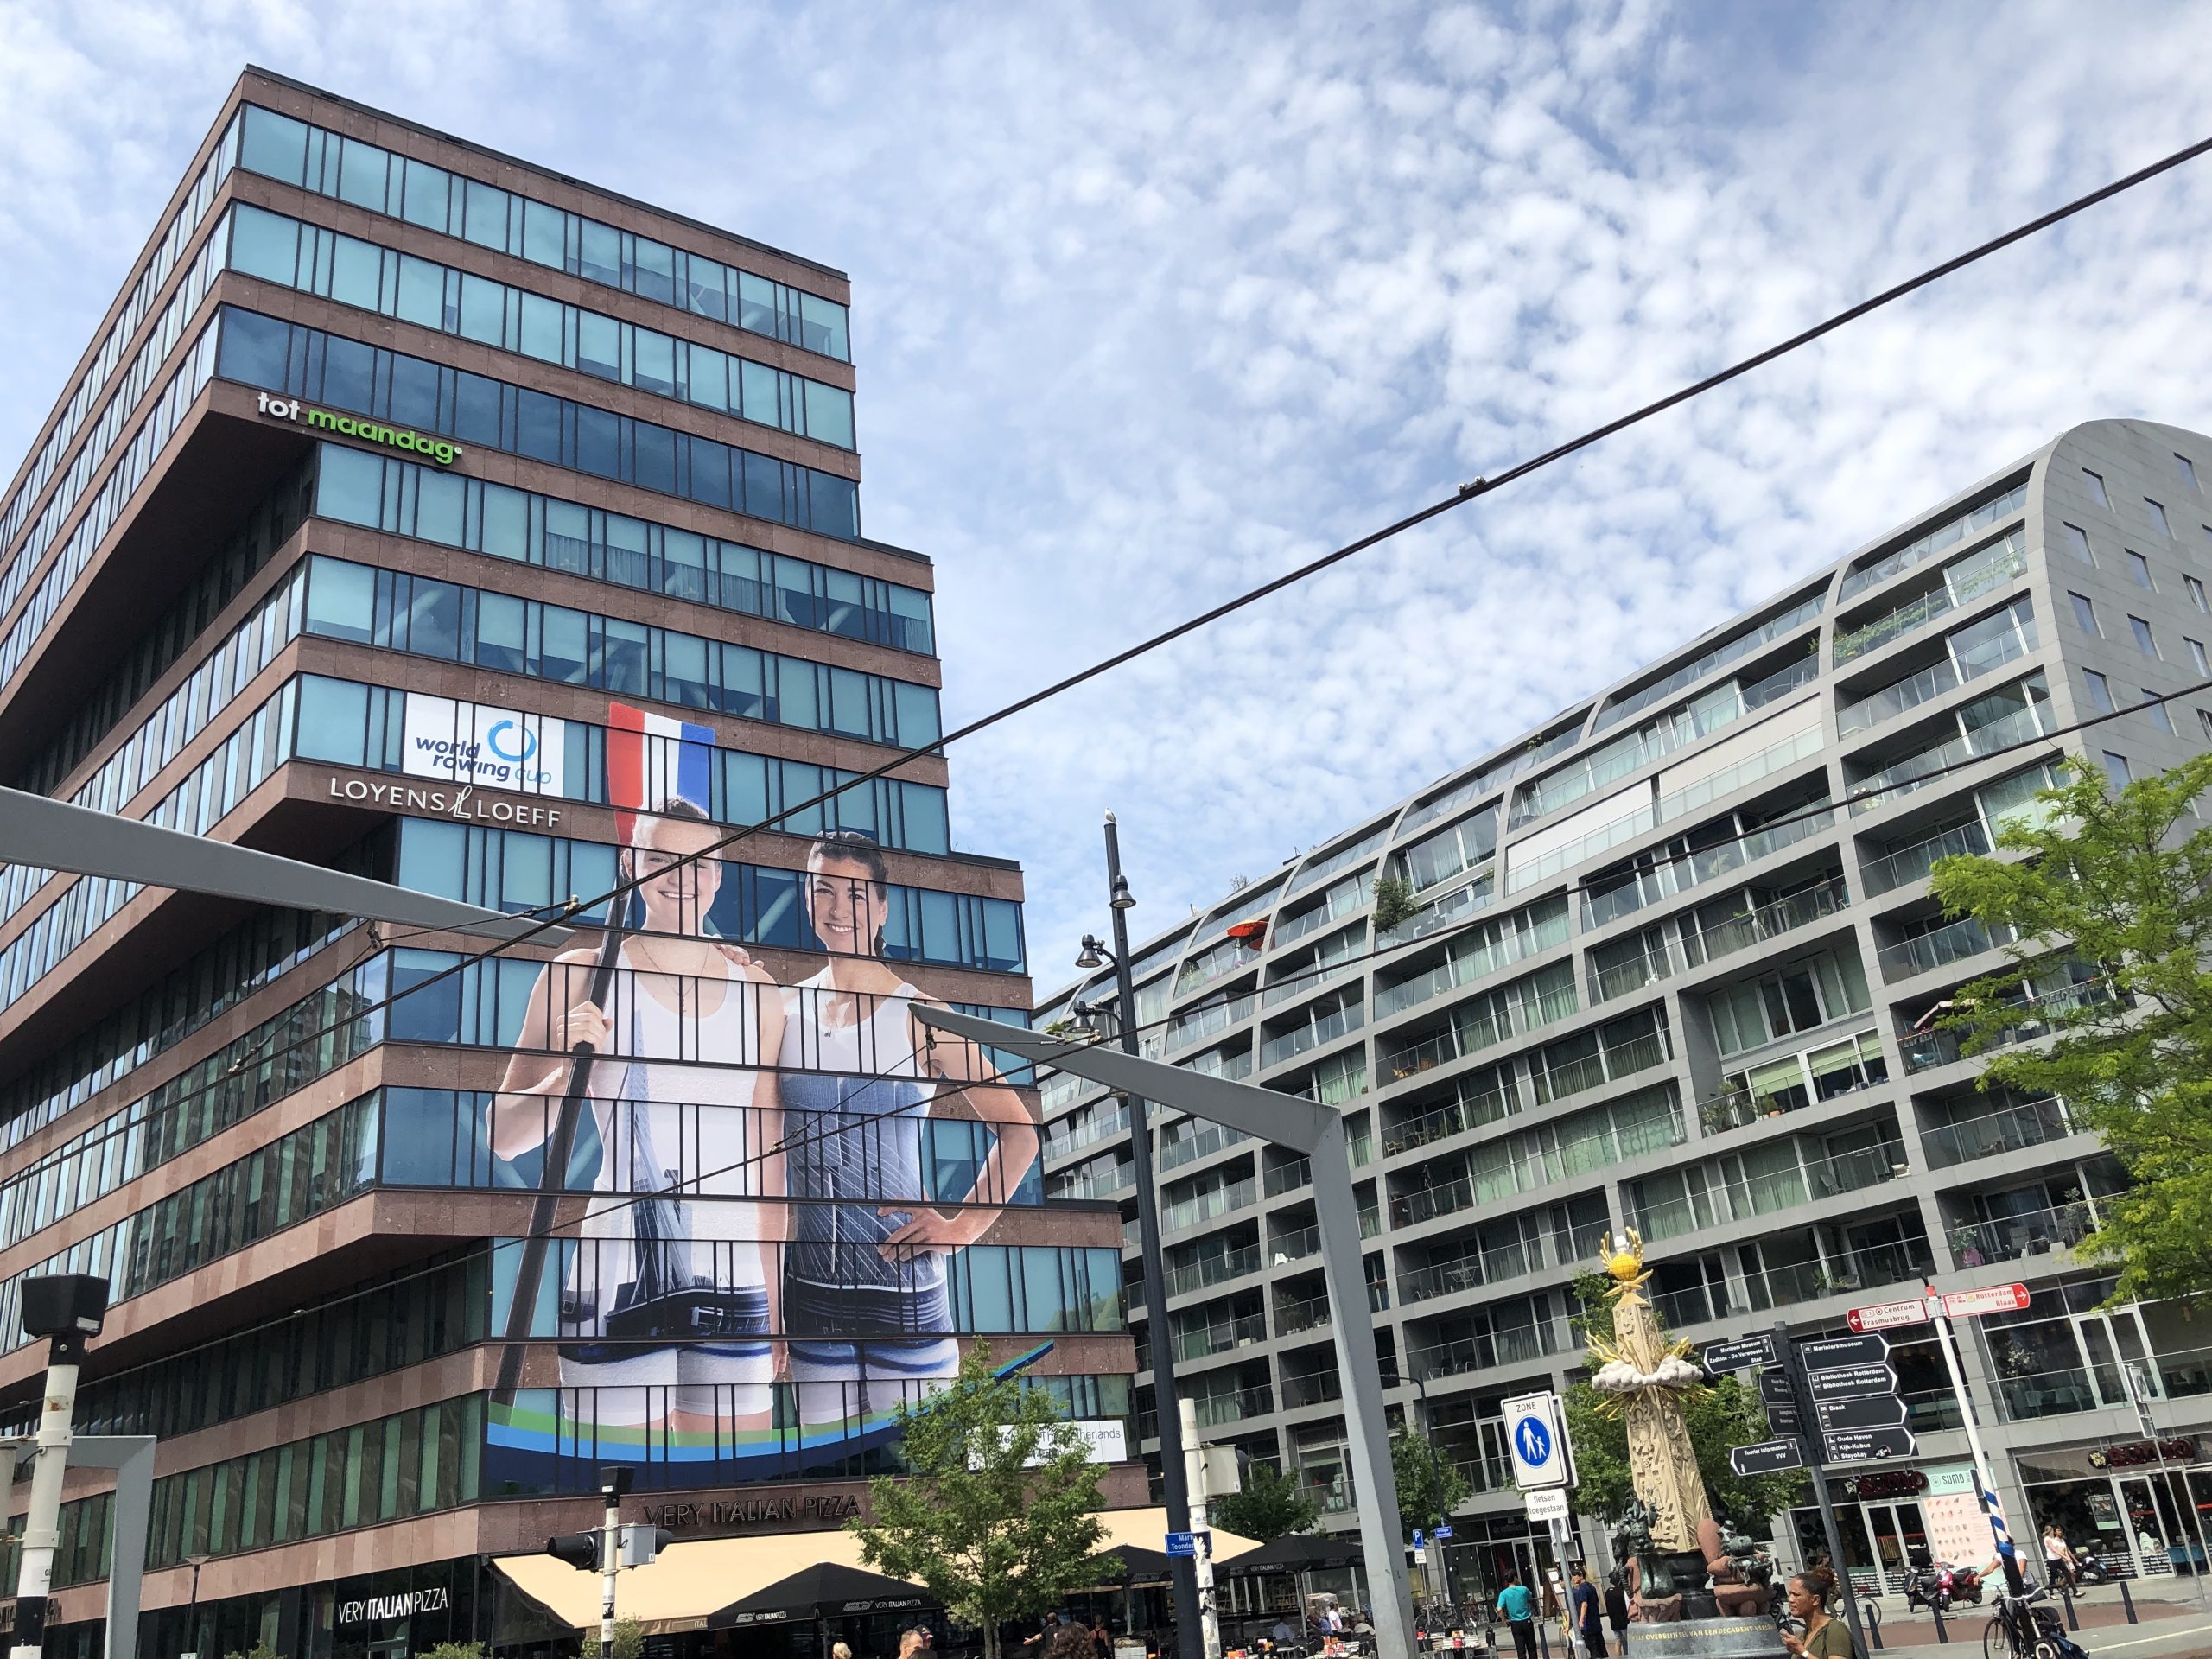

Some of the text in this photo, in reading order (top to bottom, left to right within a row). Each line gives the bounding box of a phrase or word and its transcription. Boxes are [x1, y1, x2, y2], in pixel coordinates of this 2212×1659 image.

[258, 392, 454, 465] tot maandag
[416, 737, 480, 759] world
[432, 754, 552, 785] rowing cup
[330, 777, 445, 811] LOYENS
[477, 799, 561, 828] LOEFF
[1975, 1290, 2013, 1300] Rotterdam
[1884, 1304, 1915, 1313] Centrum
[1863, 1315, 1910, 1326] Erasmusbrug
[1720, 1340, 1761, 1353] Maritiem Museum
[1813, 1340, 1863, 1351] Mariniersmuseum
[1821, 1368, 1885, 1381] Bibliotheek Rotterdam
[1822, 1381, 1854, 1389] Bibliotheek
[1855, 1376, 1886, 1385] Rotterdam
[1516, 1401, 1537, 1413] ZONE
[1760, 1445, 1788, 1453] Information
[1839, 1442, 1871, 1451] Kijk-Kubus
[1859, 1471, 1928, 1495] SUMO
[1942, 1473, 1965, 1485] SUMO
[1534, 1494, 1555, 1503] fietsen
[643, 1495, 862, 1526] VERY ITALIAN PIZZA
[1529, 1503, 1565, 1516] toegestaan
[339, 1586, 448, 1624] VERY ITALIAN PIZZA
[906, 1599, 922, 1607] PIZZA
[1719, 1625, 1753, 1635] DECADENT
